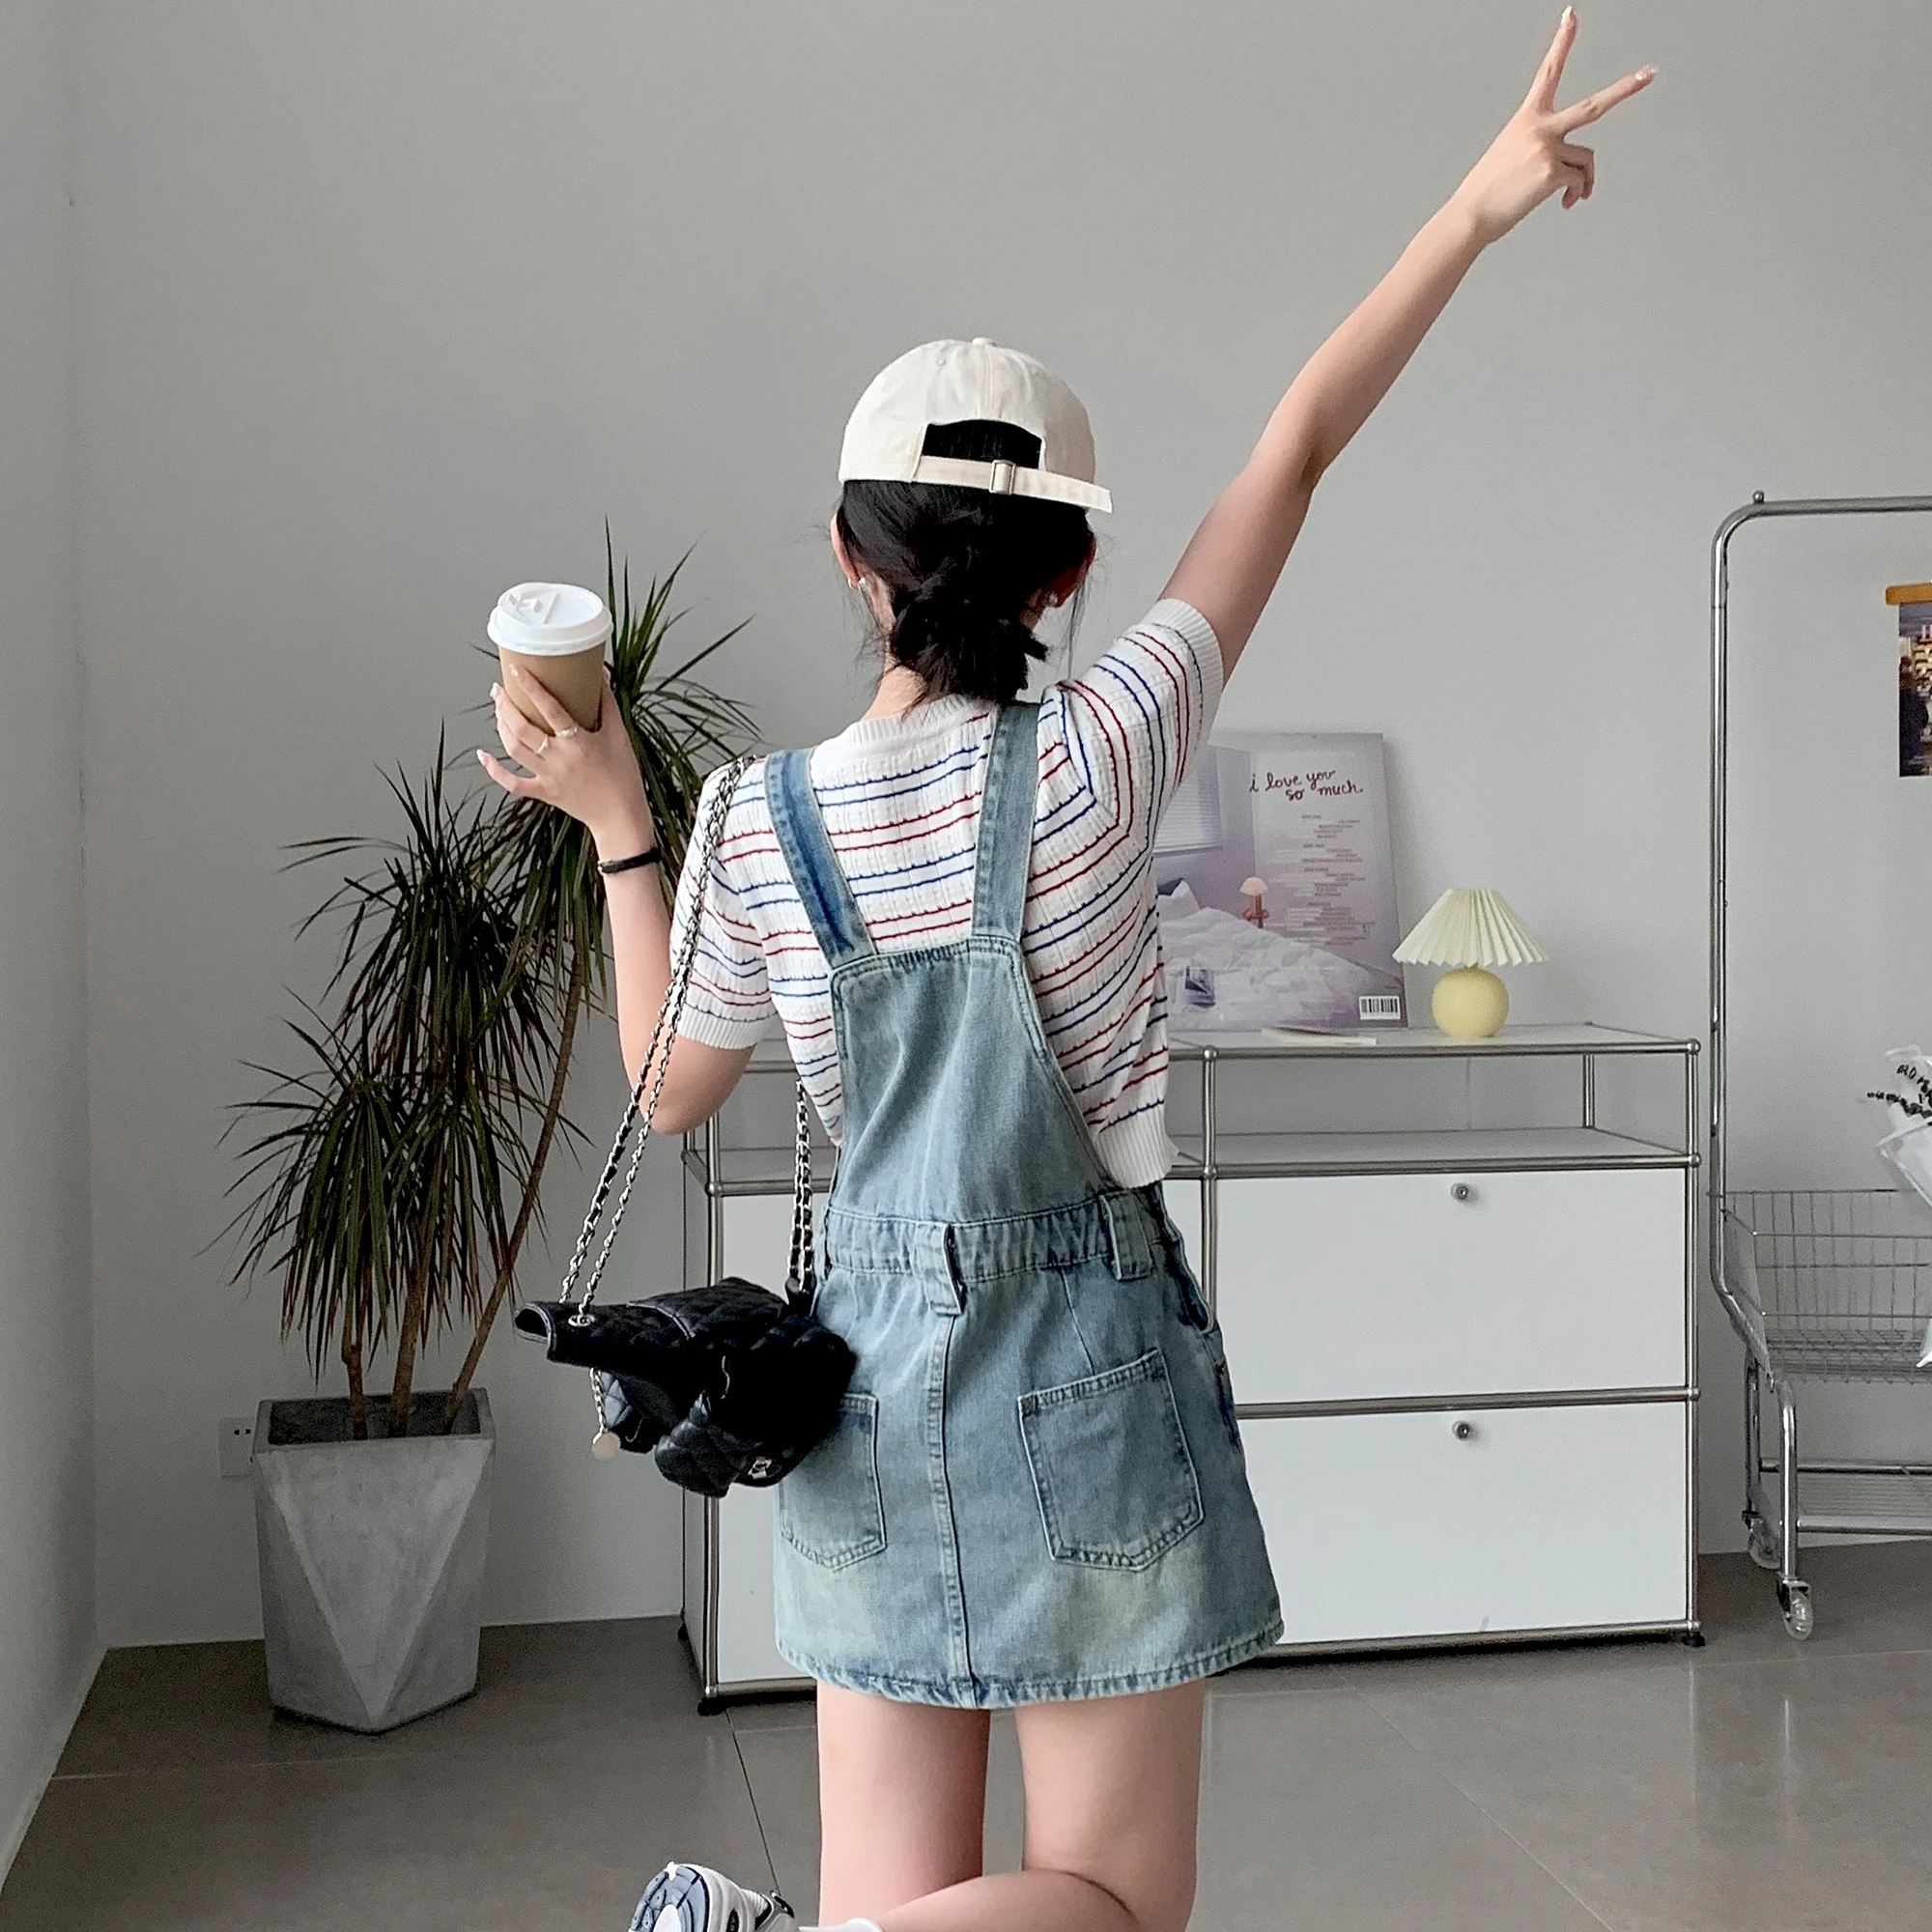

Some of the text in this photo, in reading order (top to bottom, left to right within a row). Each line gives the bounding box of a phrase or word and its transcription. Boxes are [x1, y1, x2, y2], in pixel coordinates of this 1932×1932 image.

[1249, 770, 1336, 792] i love you
[1286, 780, 1363, 801] so much.
